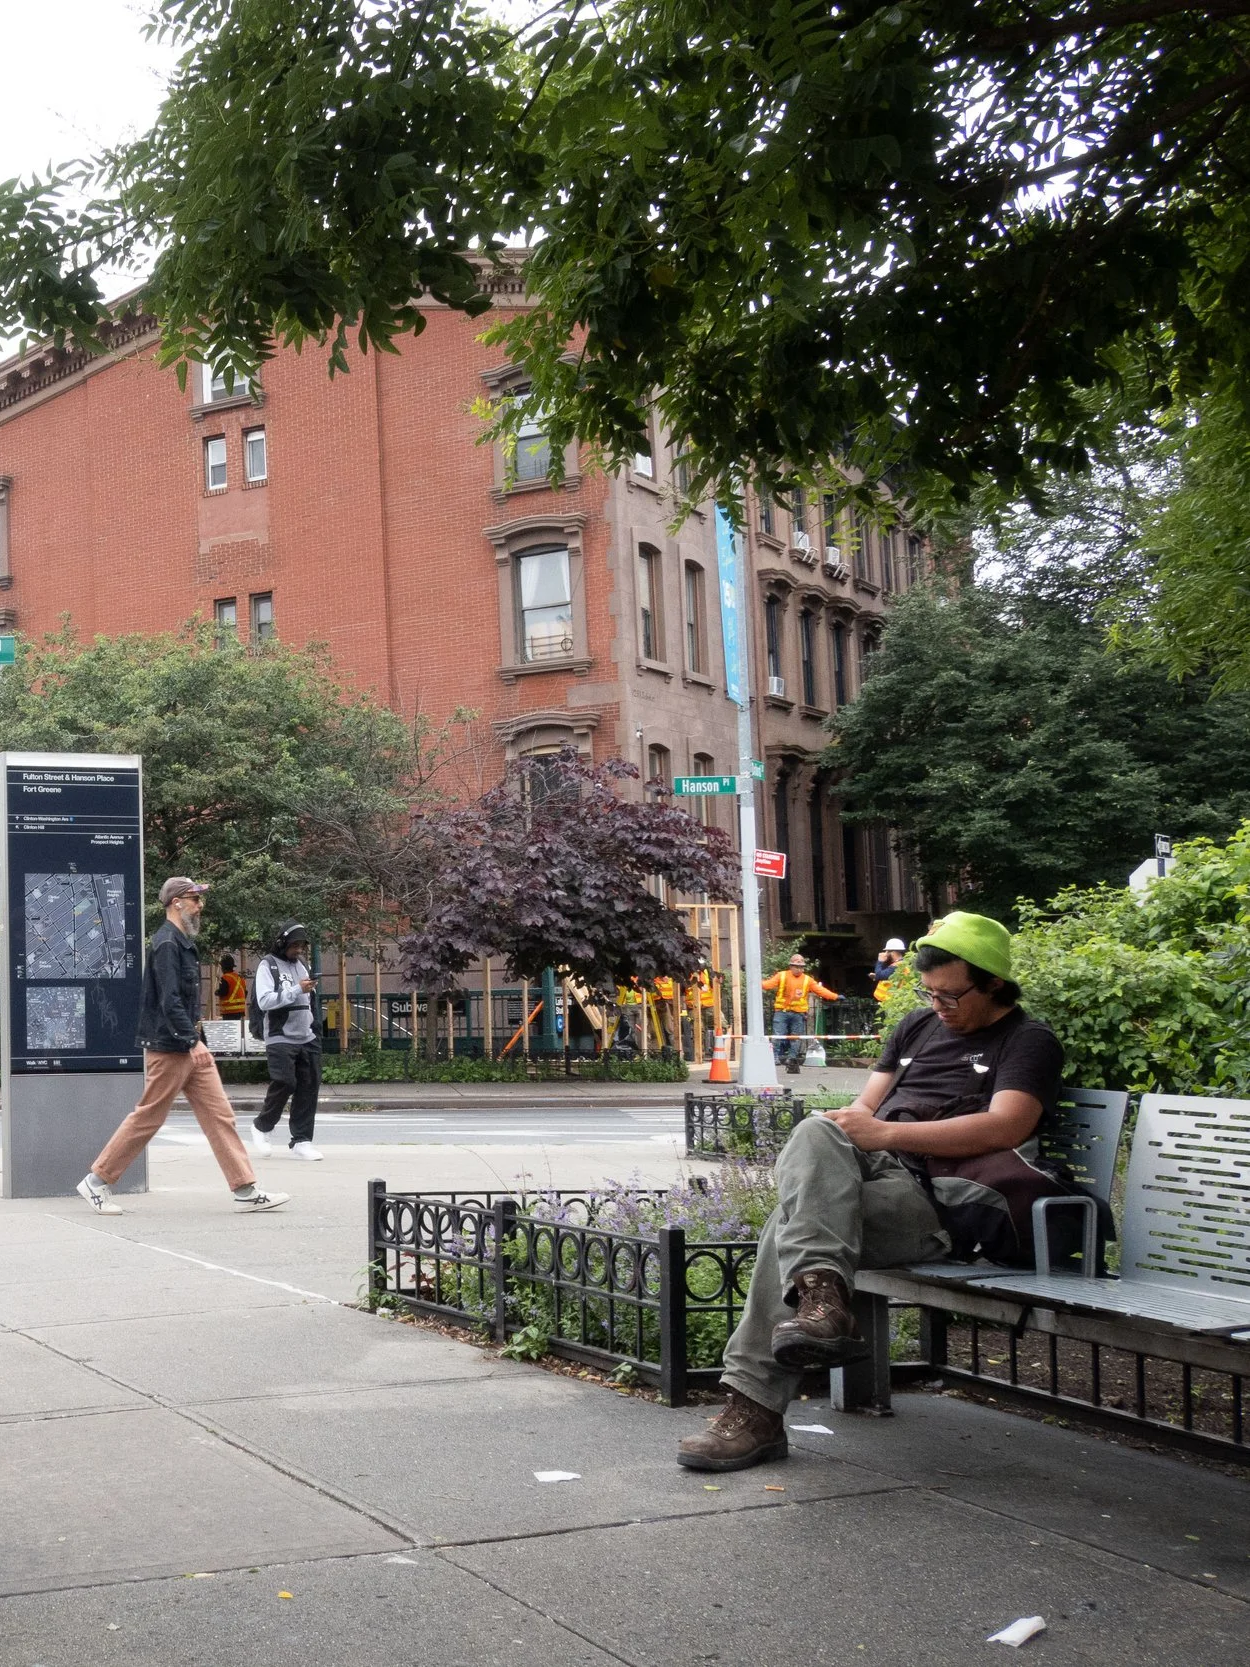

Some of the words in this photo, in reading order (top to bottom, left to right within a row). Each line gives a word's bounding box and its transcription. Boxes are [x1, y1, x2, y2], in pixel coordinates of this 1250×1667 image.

[22, 773, 43, 781] Fulton
[44, 773, 65, 782] Street
[71, 774, 96, 782] Hanson
[96, 774, 115, 782] Place
[22, 785, 37, 793] Fort
[37, 785, 62, 794] Greene
[681, 780, 720, 793] Hanson
[722, 778, 730, 787] Pl
